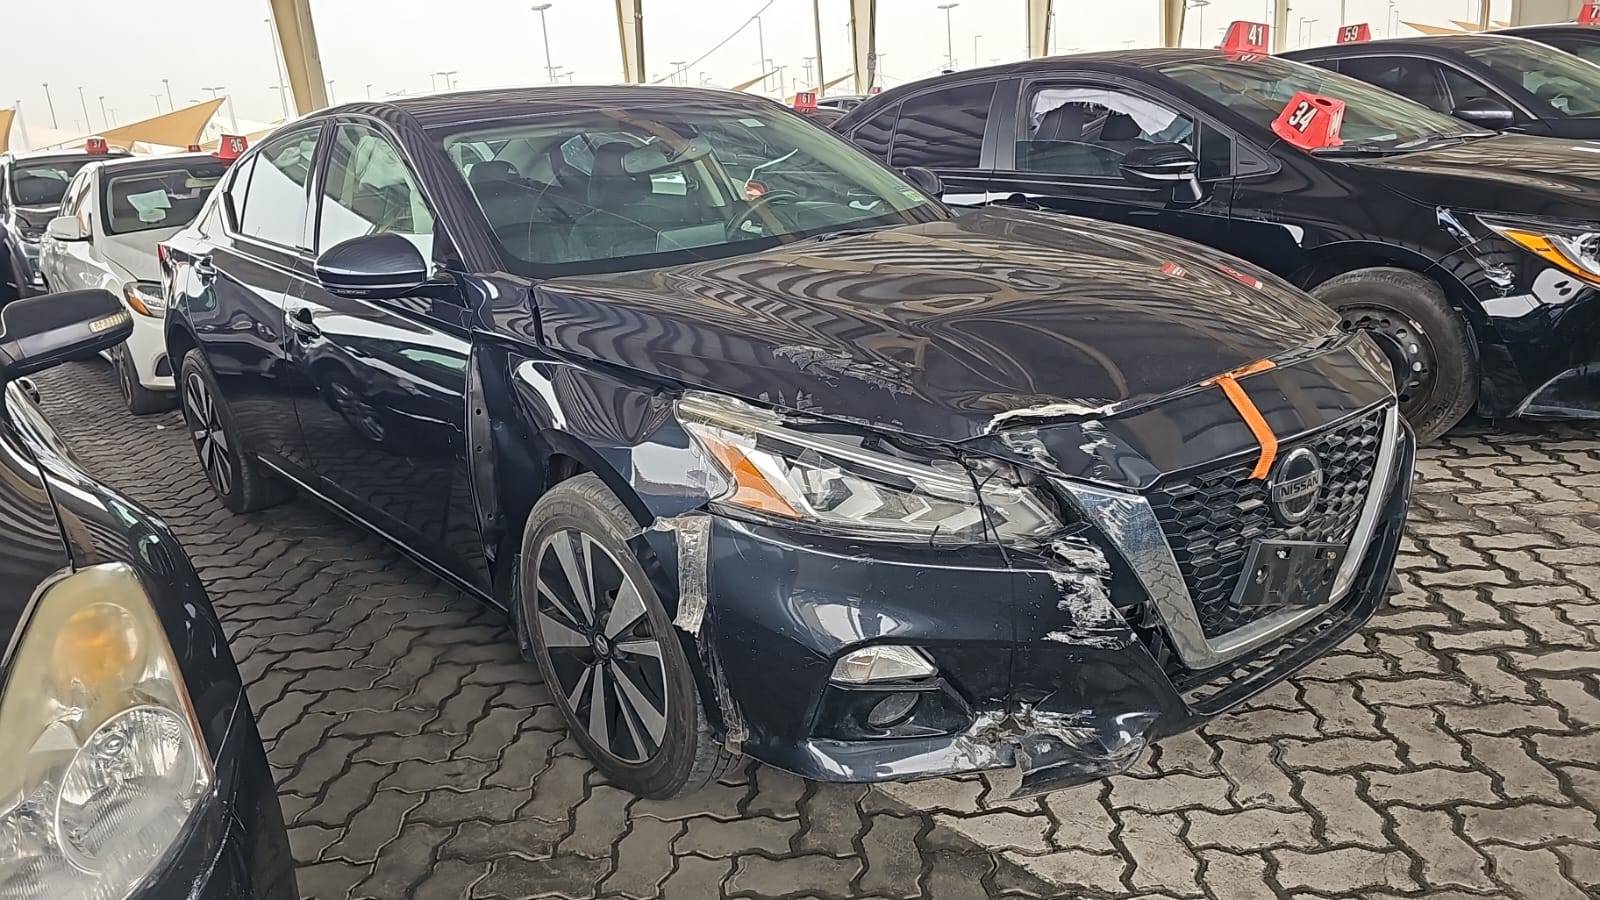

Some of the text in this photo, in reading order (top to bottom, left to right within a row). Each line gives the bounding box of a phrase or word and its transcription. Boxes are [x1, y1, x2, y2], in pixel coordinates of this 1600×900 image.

[1248, 24, 1264, 46] 41
[1344, 26, 1359, 42] 59
[1288, 101, 1318, 132] 34
[230, 138, 244, 153] 36
[1281, 475, 1319, 497] NISSAN
